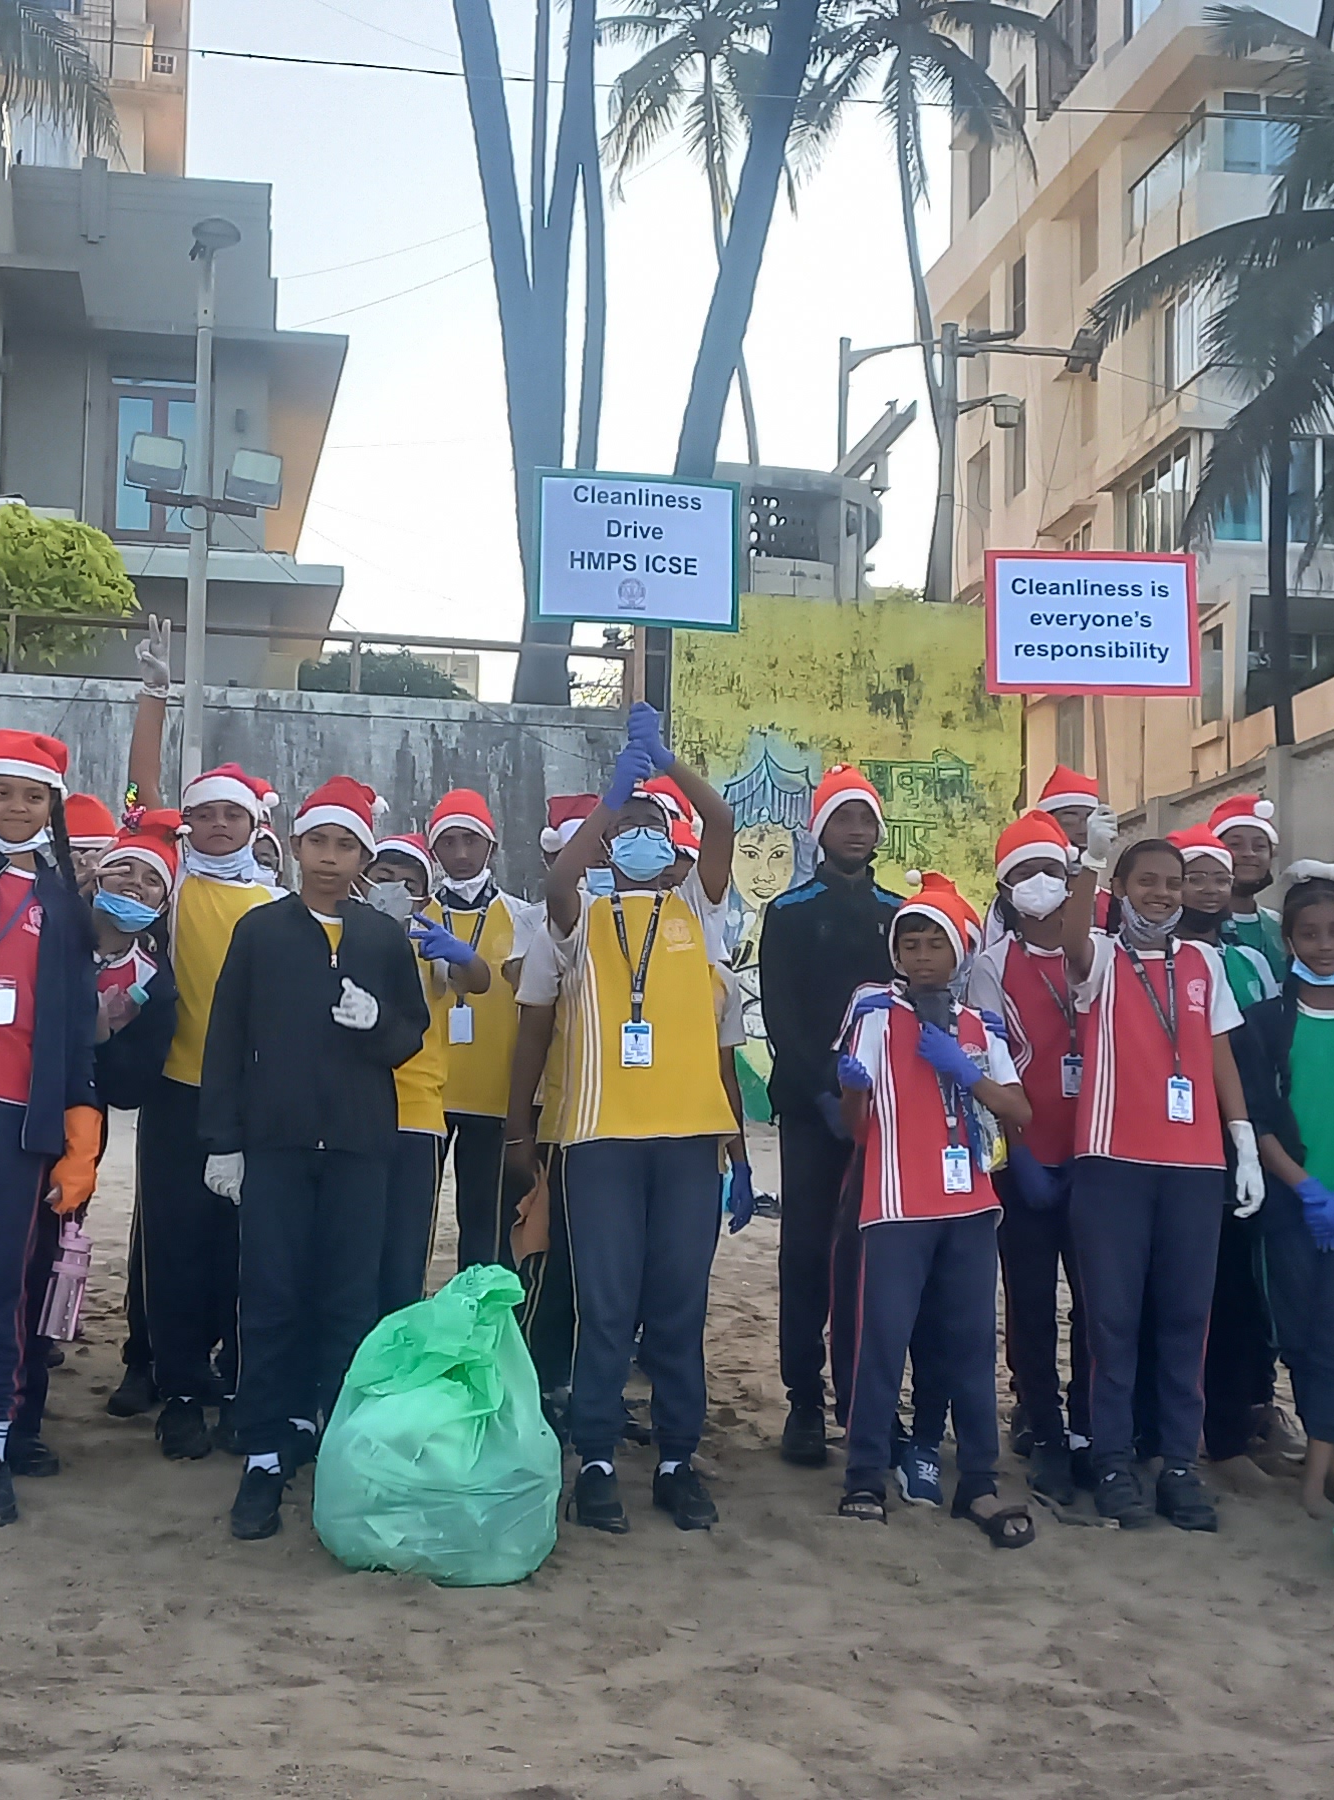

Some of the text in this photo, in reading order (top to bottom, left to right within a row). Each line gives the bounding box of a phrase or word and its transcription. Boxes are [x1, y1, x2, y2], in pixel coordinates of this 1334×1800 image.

[573, 485, 702, 510] Cleanliness
[606, 519, 664, 540] Drive
[570, 550, 698, 576] HMPS ICSE
[1011, 577, 1170, 598] Cleanliness is
[1014, 641, 1170, 664] responsibility
